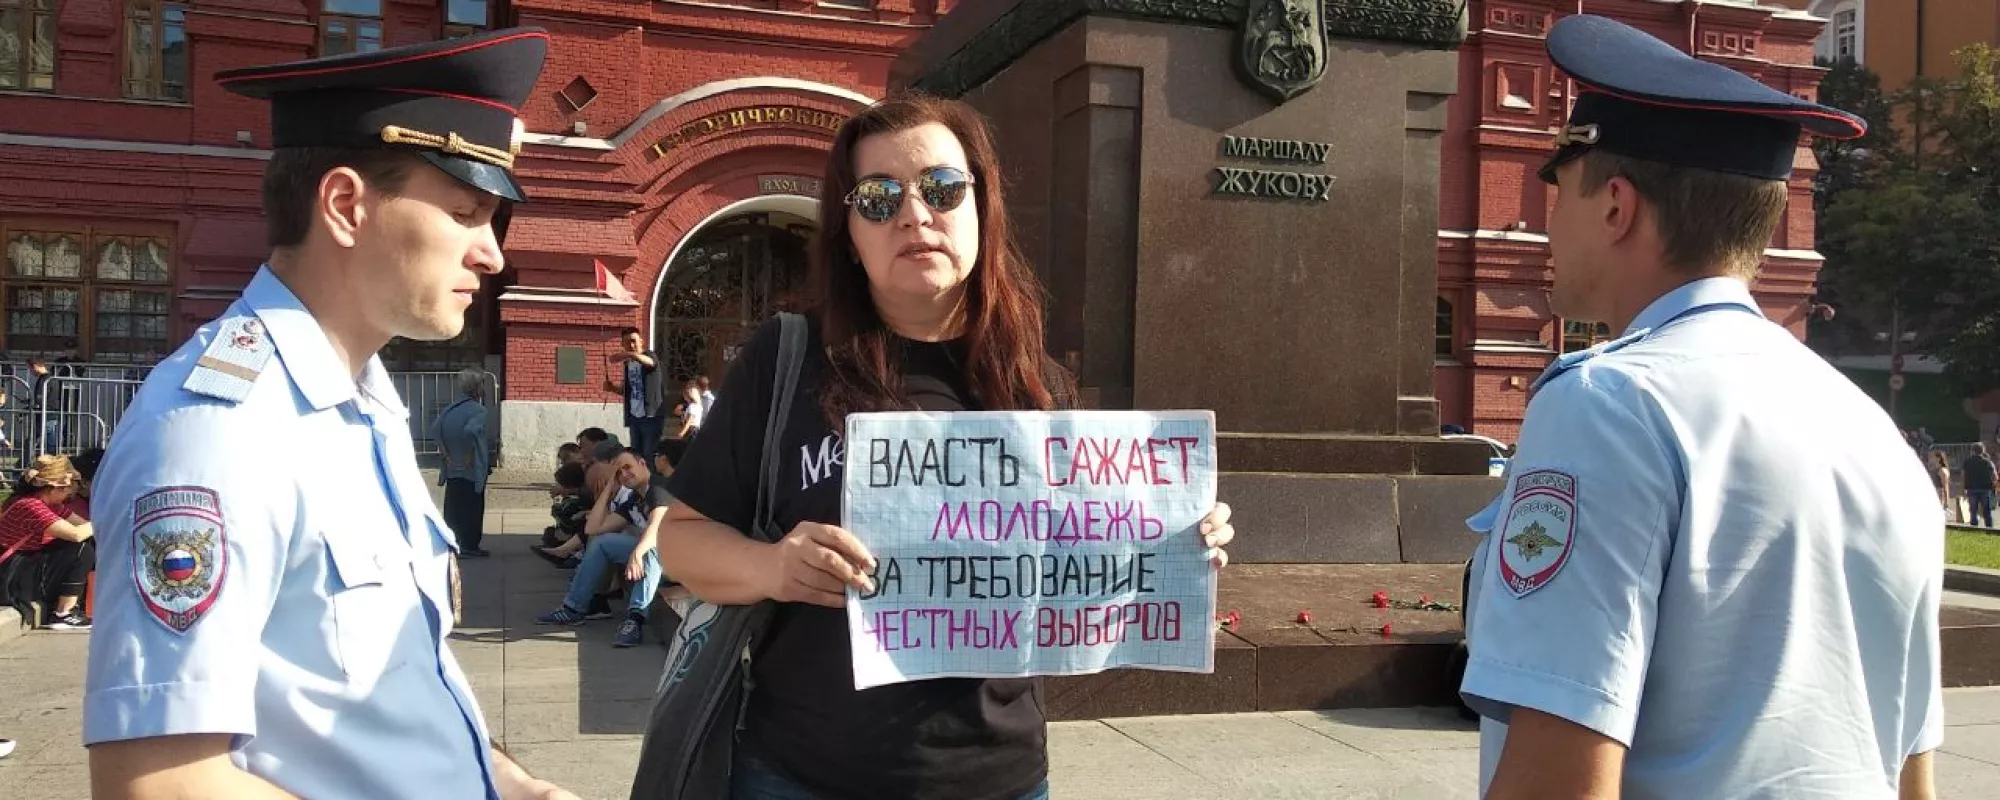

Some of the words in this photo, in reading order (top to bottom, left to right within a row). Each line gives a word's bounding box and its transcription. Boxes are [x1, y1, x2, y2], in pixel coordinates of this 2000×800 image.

[1224, 134, 1333, 162] МАРШАЛУ
[1216, 167, 1337, 200] ЖУКОВУ
[868, 437, 1020, 488] ВЛАСТЬ
[1044, 436, 1200, 487] САЖАЕТ
[931, 500, 1165, 548] МОЛОДЕЖЬ
[916, 552, 1156, 600] ТРЕБОВАНИЕ
[166, 609, 199, 630] МВД
[861, 607, 1022, 653] ЧЕСТНЫХ
[1036, 601, 1181, 649] ВЫБОРОВ
